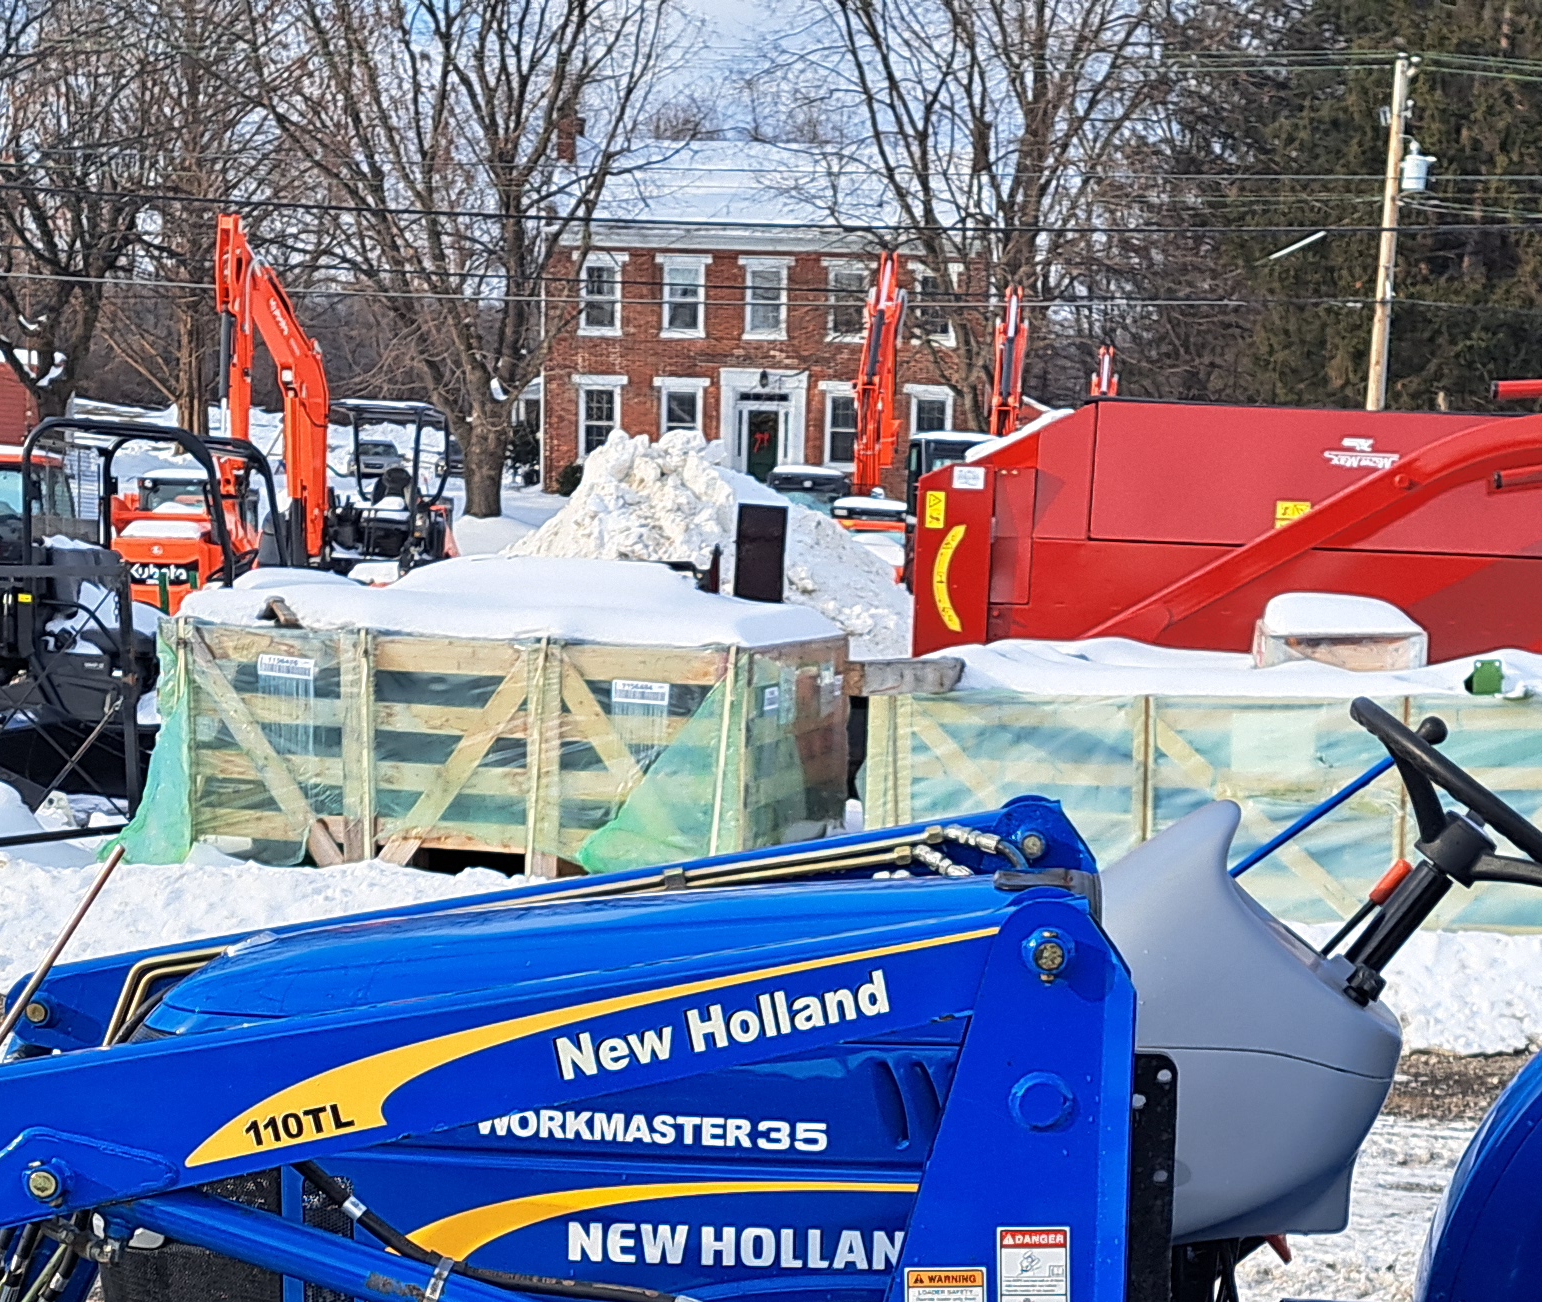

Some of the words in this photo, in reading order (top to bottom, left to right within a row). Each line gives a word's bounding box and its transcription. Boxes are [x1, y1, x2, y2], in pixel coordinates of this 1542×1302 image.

[130, 563, 187, 580] Kubota
[554, 1026, 673, 1080] New
[686, 969, 890, 1053] Holland
[245, 1104, 355, 1146] 110TL
[478, 1110, 752, 1149] WORKMASTER
[757, 1120, 828, 1151] 35
[568, 1221, 688, 1264] NEW
[701, 1226, 905, 1270] HOLLAN
[1015, 1234, 1064, 1244] DANGER
[928, 1275, 977, 1284] WARNING
